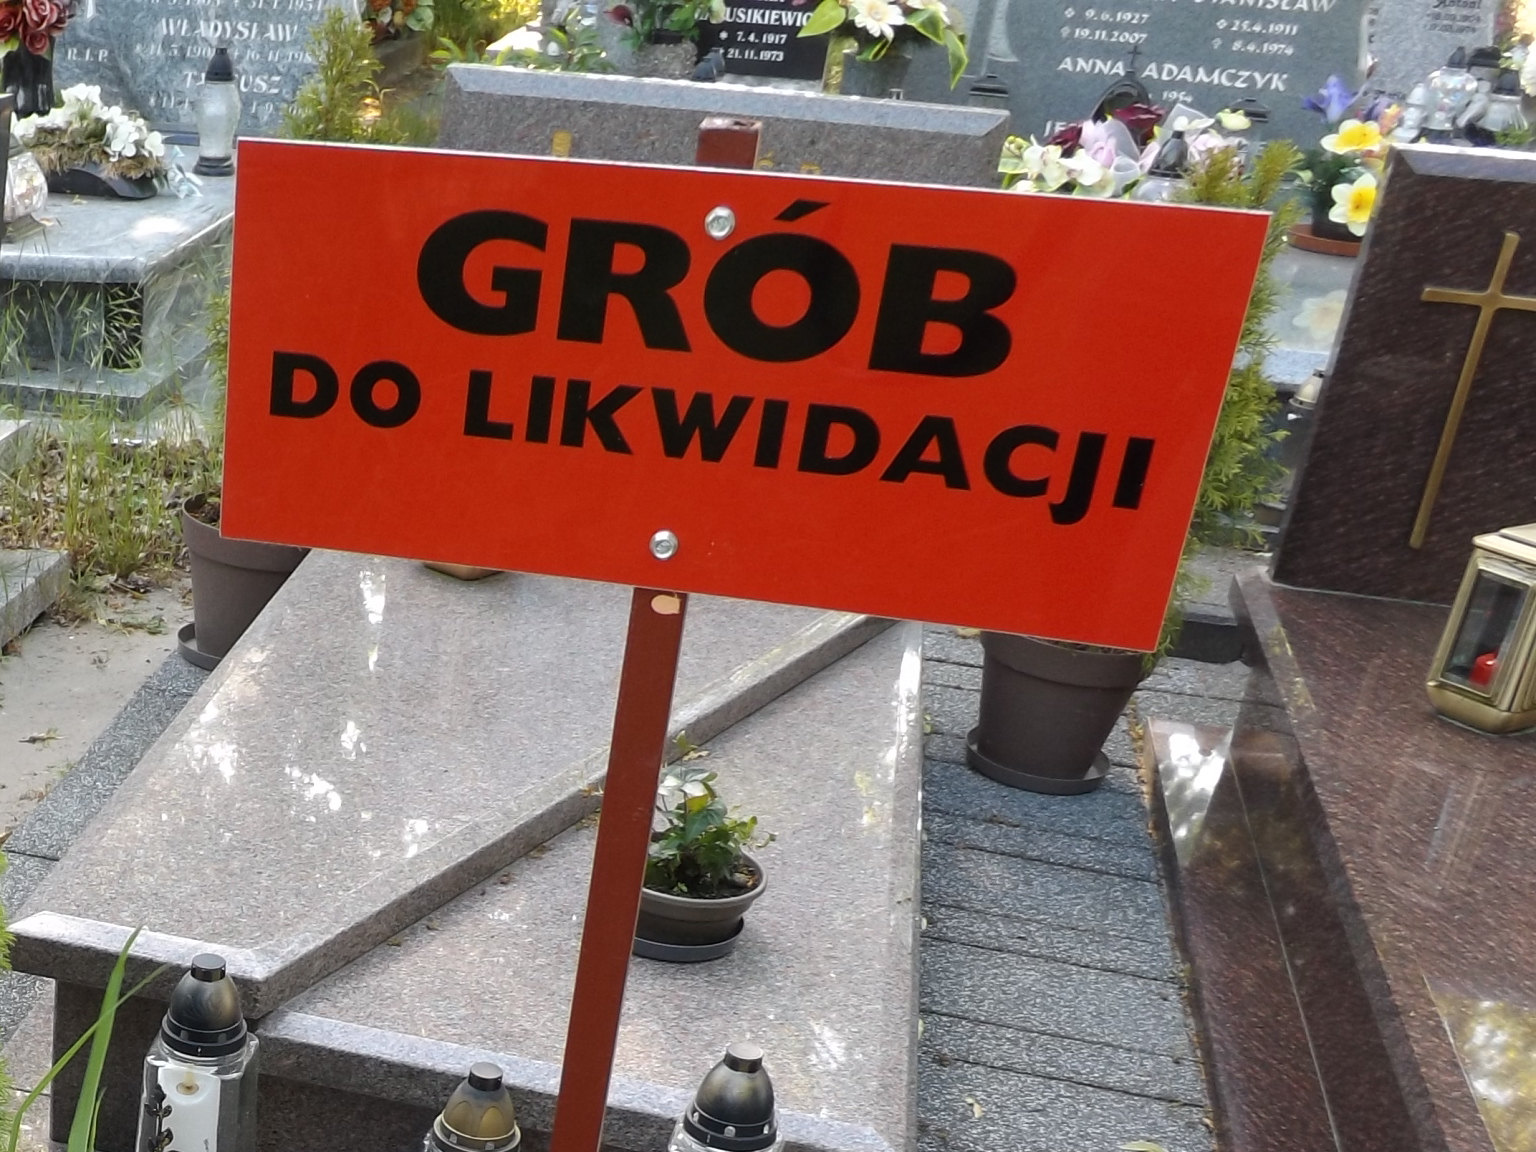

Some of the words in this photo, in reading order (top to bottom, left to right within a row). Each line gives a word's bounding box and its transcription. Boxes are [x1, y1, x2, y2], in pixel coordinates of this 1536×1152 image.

[1057, 56, 1126, 76] ANNA
[1141, 61, 1290, 92] ADAMCZYK
[418, 200, 1017, 377] GRÓB
[270, 352, 420, 428] DO
[464, 370, 1154, 524] LIKWIDACJI
